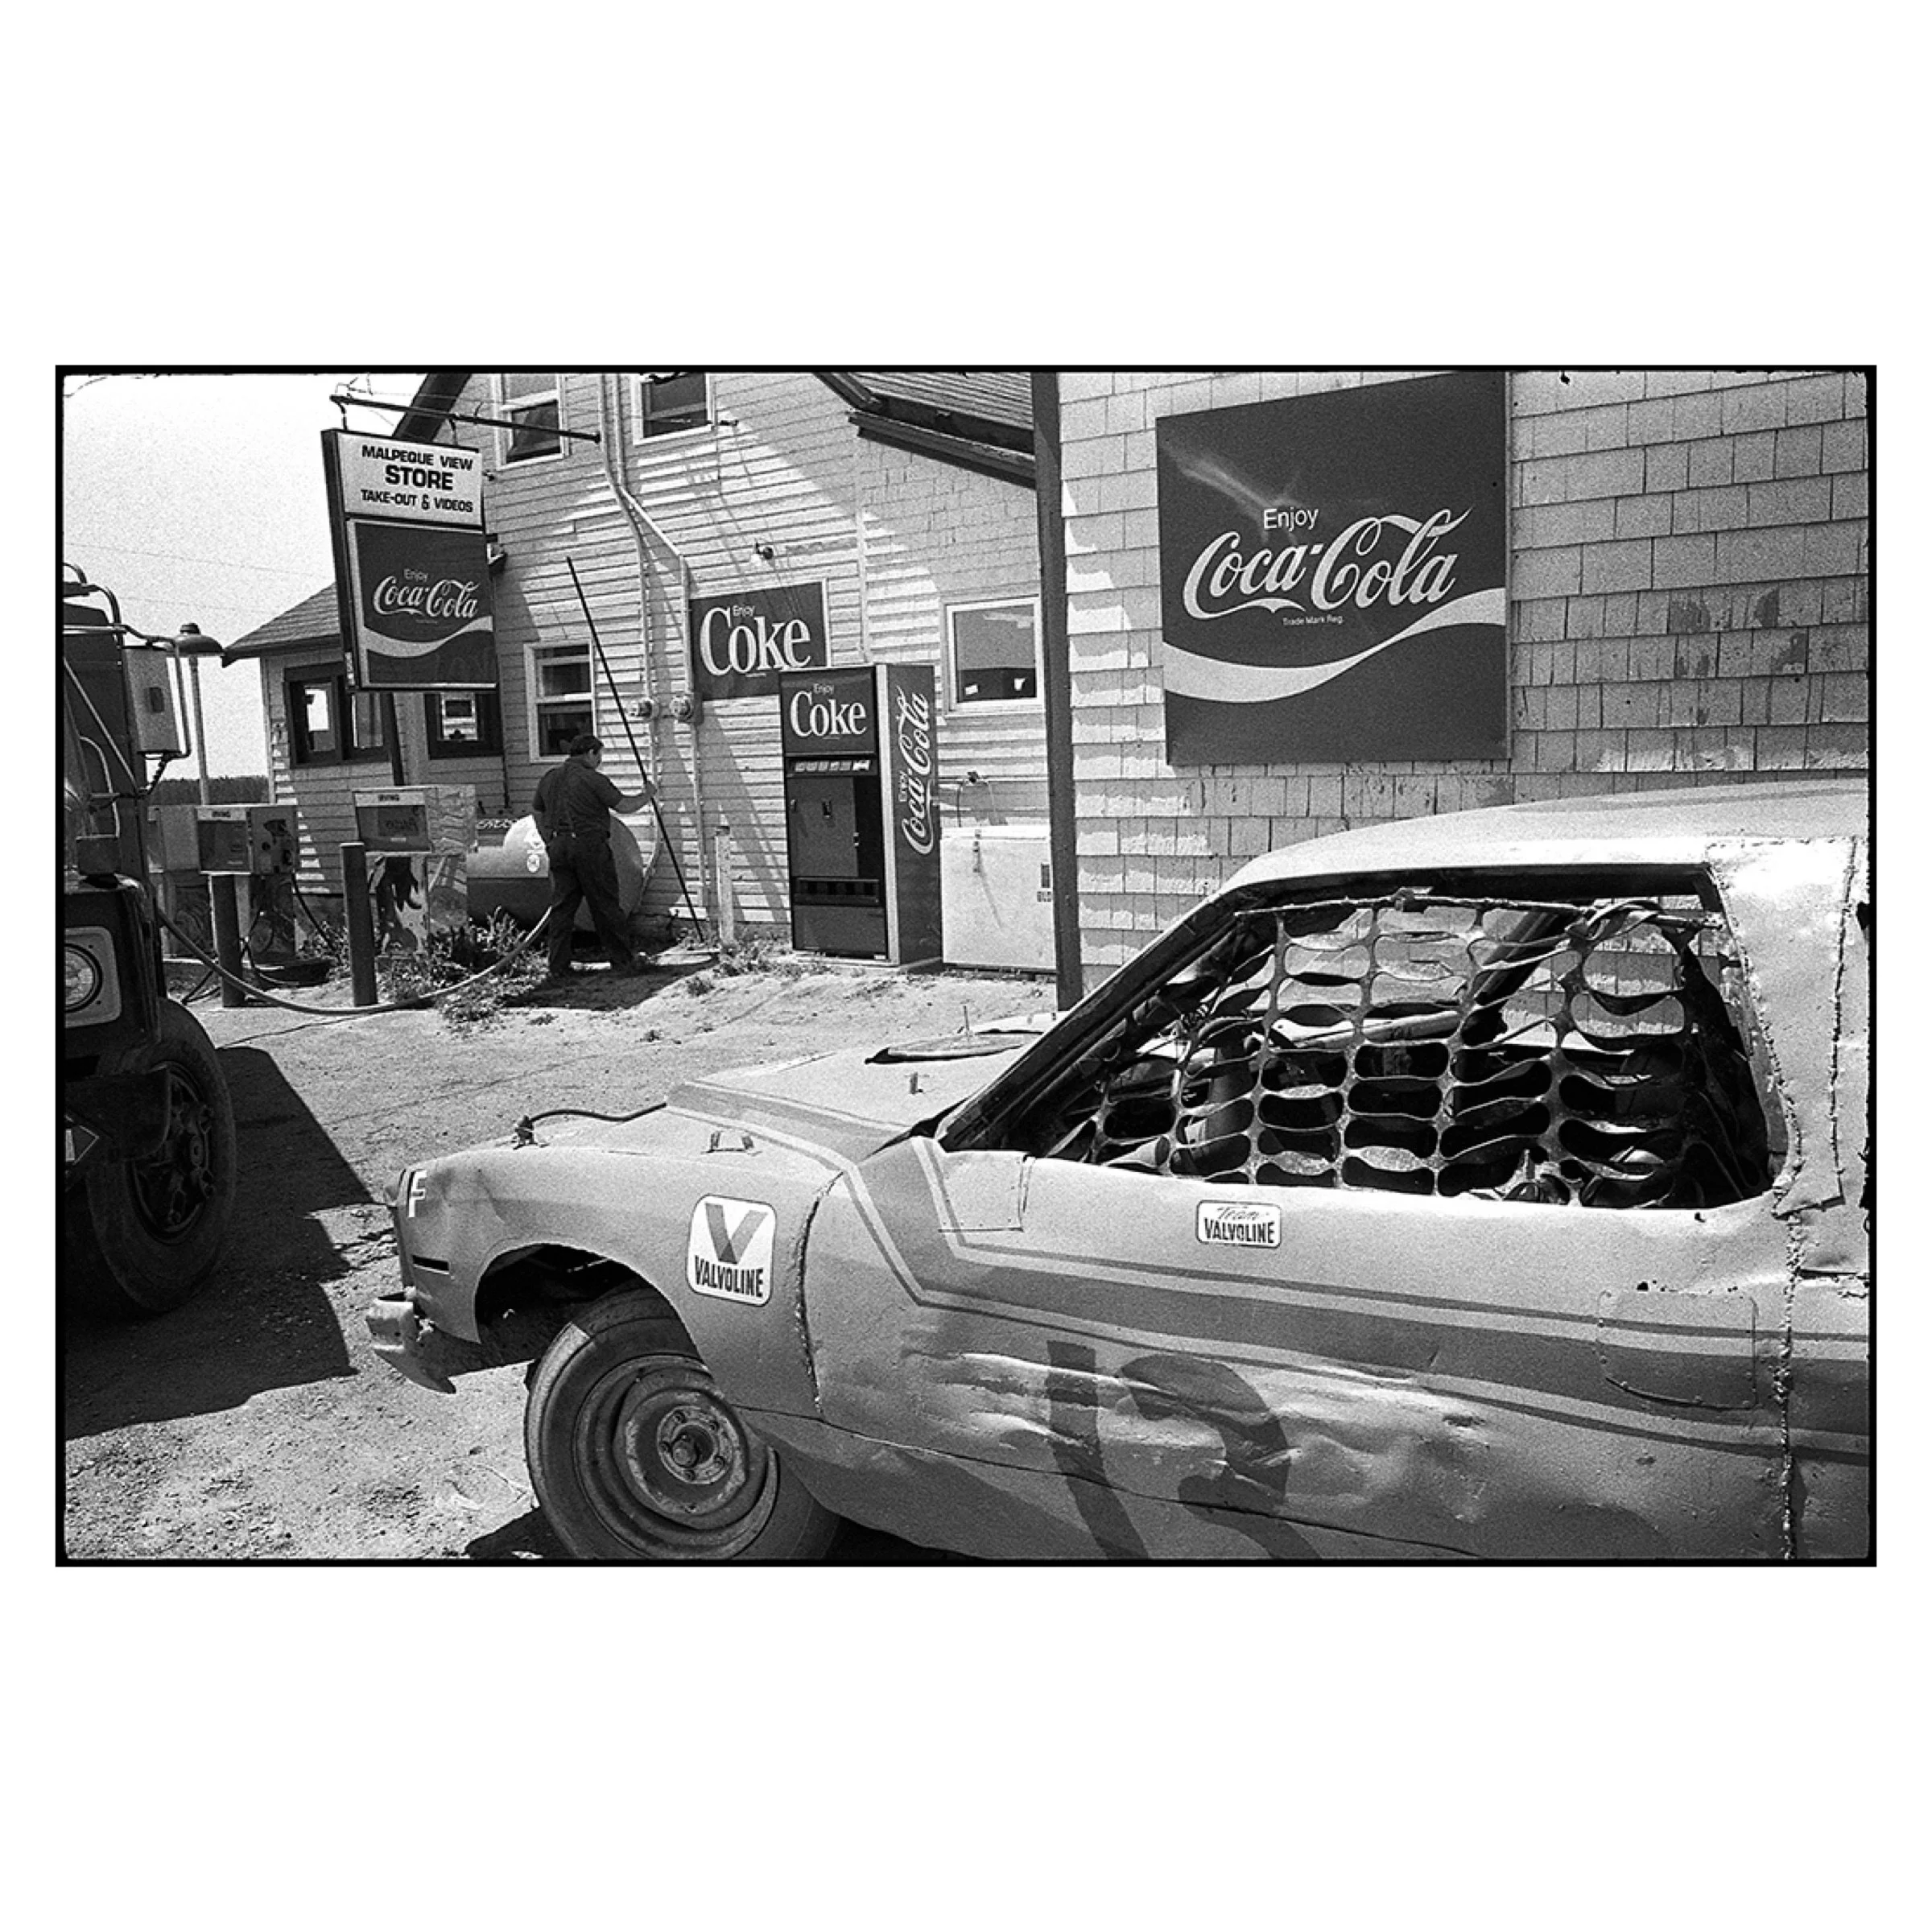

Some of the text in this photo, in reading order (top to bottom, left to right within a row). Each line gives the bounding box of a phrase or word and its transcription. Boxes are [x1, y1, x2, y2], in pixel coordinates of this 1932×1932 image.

[362, 444, 473, 471] MALPEQUE VIEW
[385, 464, 453, 491] STORE
[361, 489, 473, 513] TAKE-OUT & VIDEOS
[1263, 507, 1319, 531] Enjoy
[403, 568, 429, 582] Enjoy
[1183, 504, 1474, 620] Coca-Cola
[374, 575, 481, 618] Coca-Cola
[733, 605, 755, 617] Enjoy
[700, 606, 811, 676] Coke
[813, 683, 834, 695] Enjoy
[791, 690, 867, 737] Coke
[896, 685, 934, 855] Coca-Cola
[1203, 1216, 1275, 1244] VALVOLINE
[695, 1254, 764, 1298] VALVOLINE
